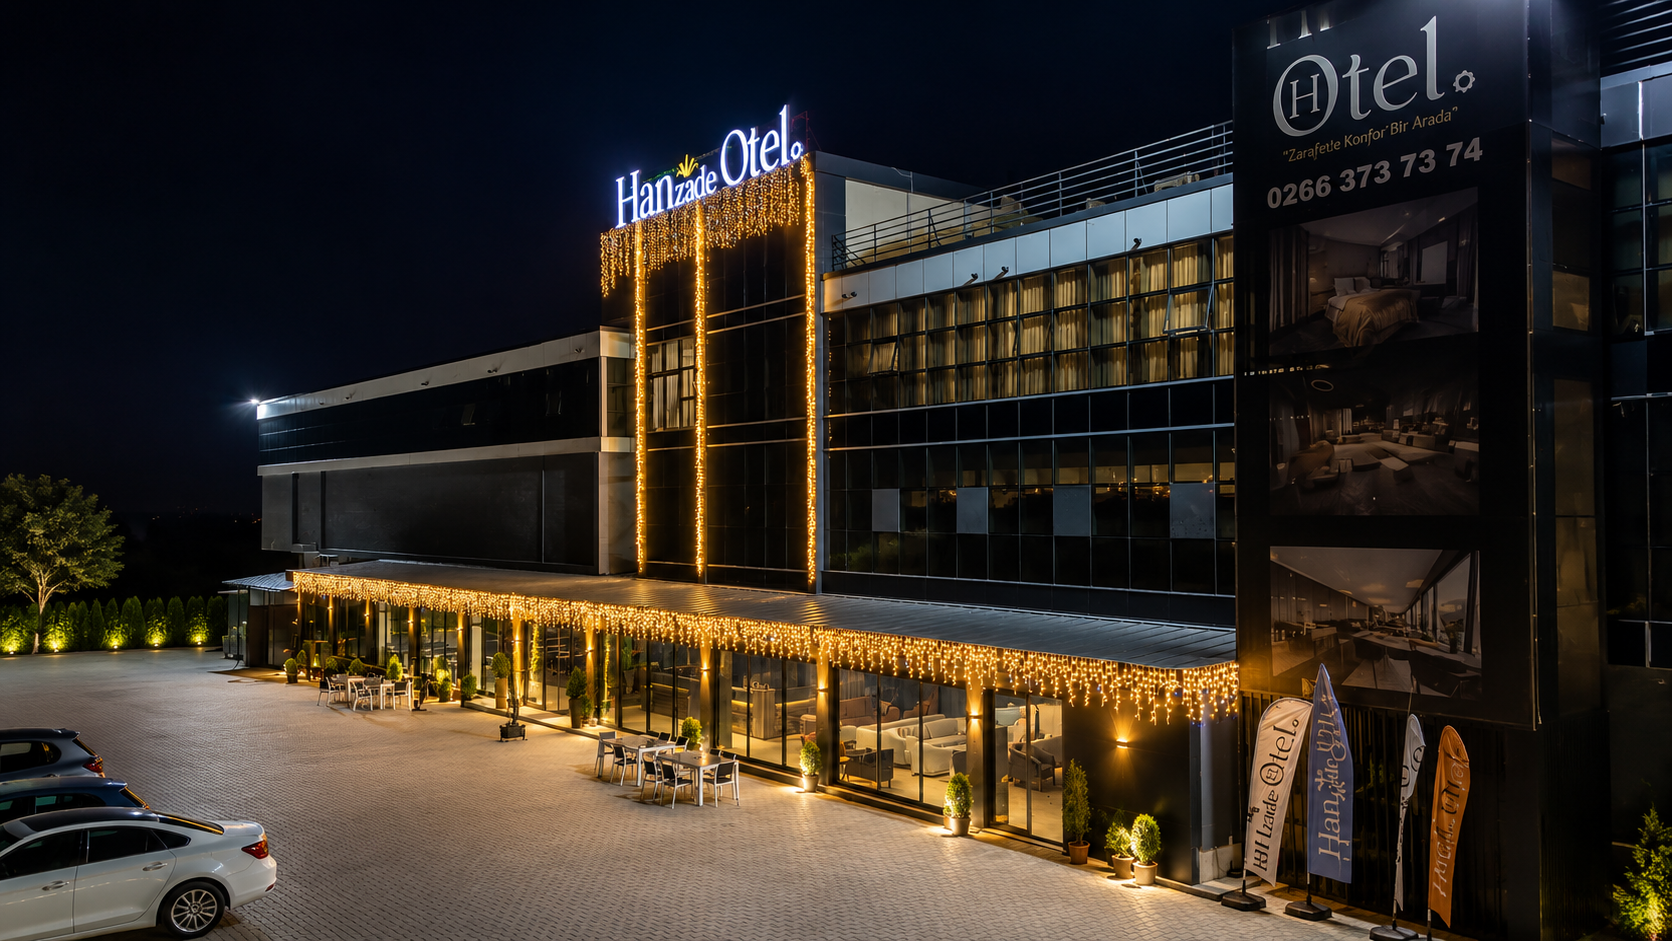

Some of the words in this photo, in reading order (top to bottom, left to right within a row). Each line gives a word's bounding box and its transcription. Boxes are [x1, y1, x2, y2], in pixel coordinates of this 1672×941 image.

[1390, 120, 1409, 136] Bir
[615, 165, 717, 229] Hanzade
[1267, 175, 1332, 209] 0266
[1339, 160, 1391, 192] 373
[1400, 149, 1436, 178] 73
[1446, 136, 1483, 167] 74
